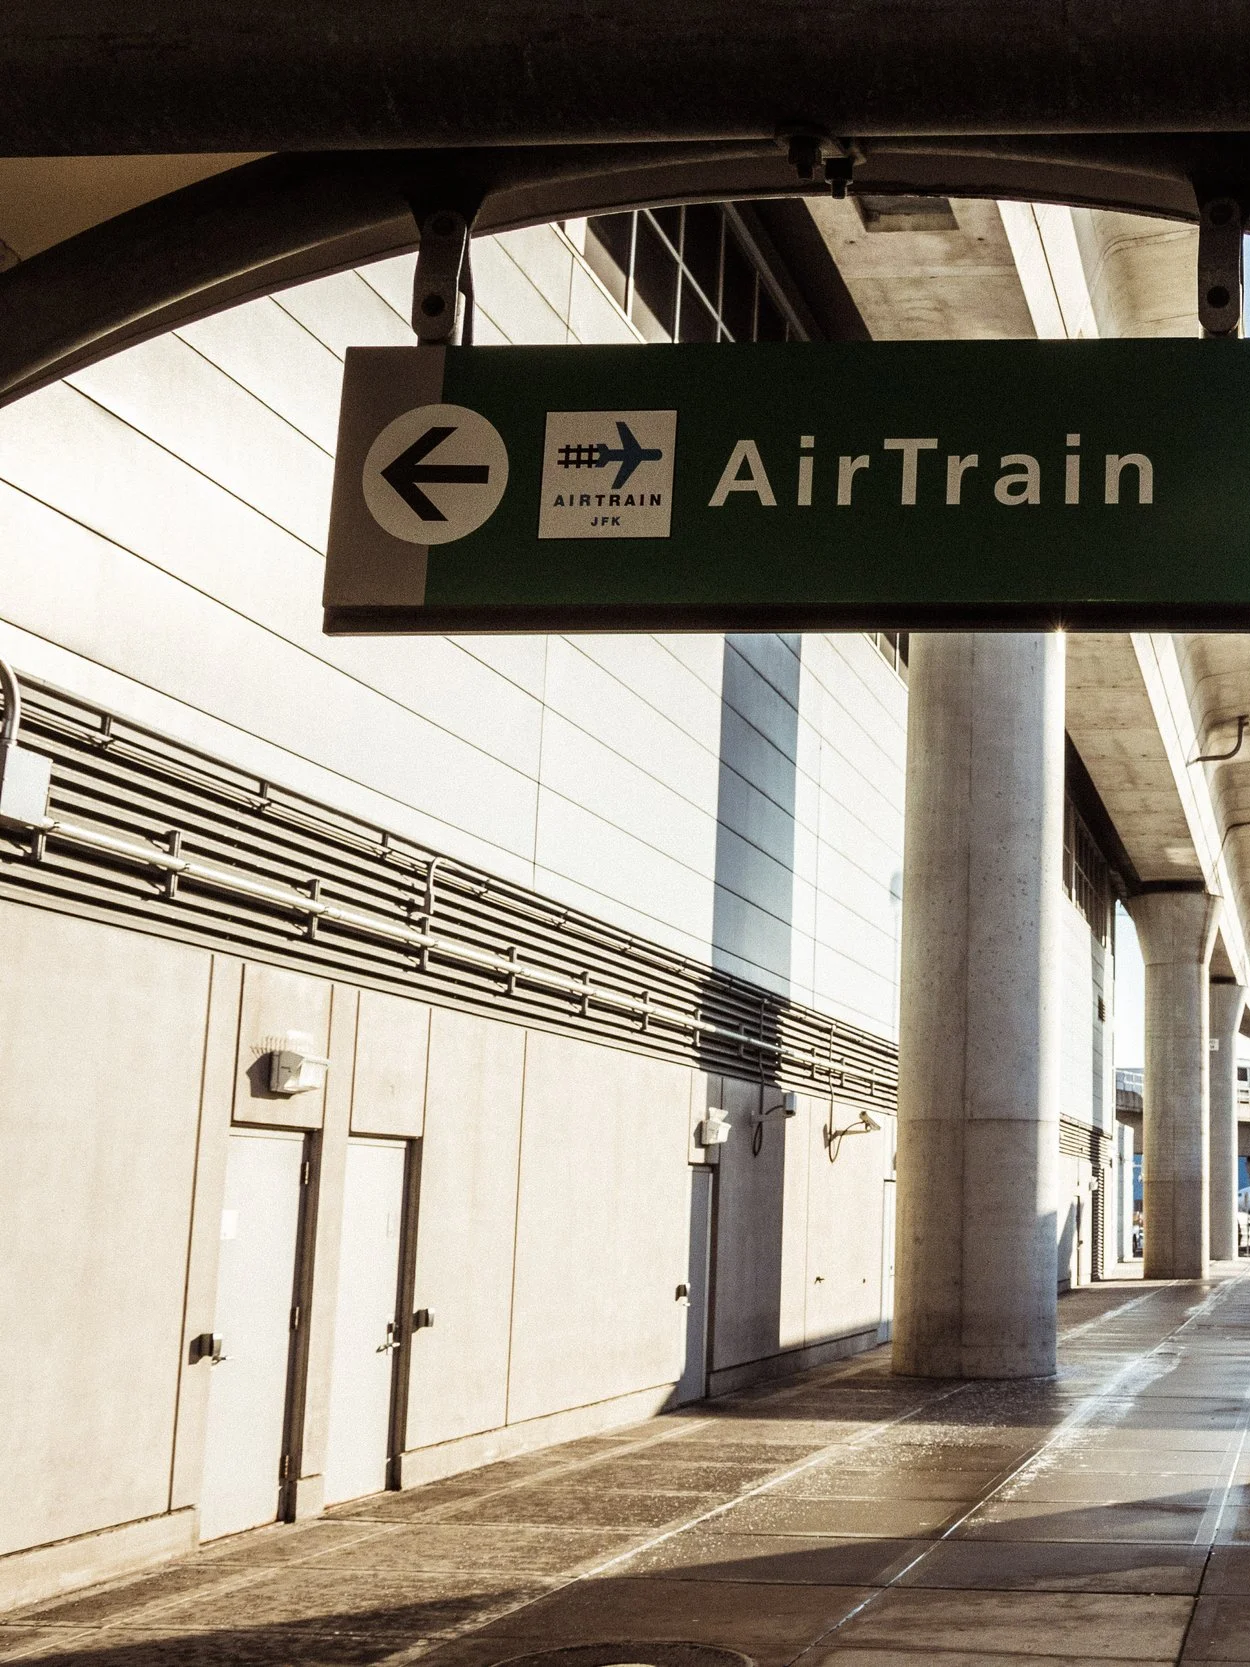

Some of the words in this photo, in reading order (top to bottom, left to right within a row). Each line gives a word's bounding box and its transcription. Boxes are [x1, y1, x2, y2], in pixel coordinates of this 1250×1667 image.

[708, 433, 1154, 507] AirTrain
[553, 493, 662, 507] AIRTRAIN
[590, 516, 621, 527] JFK
